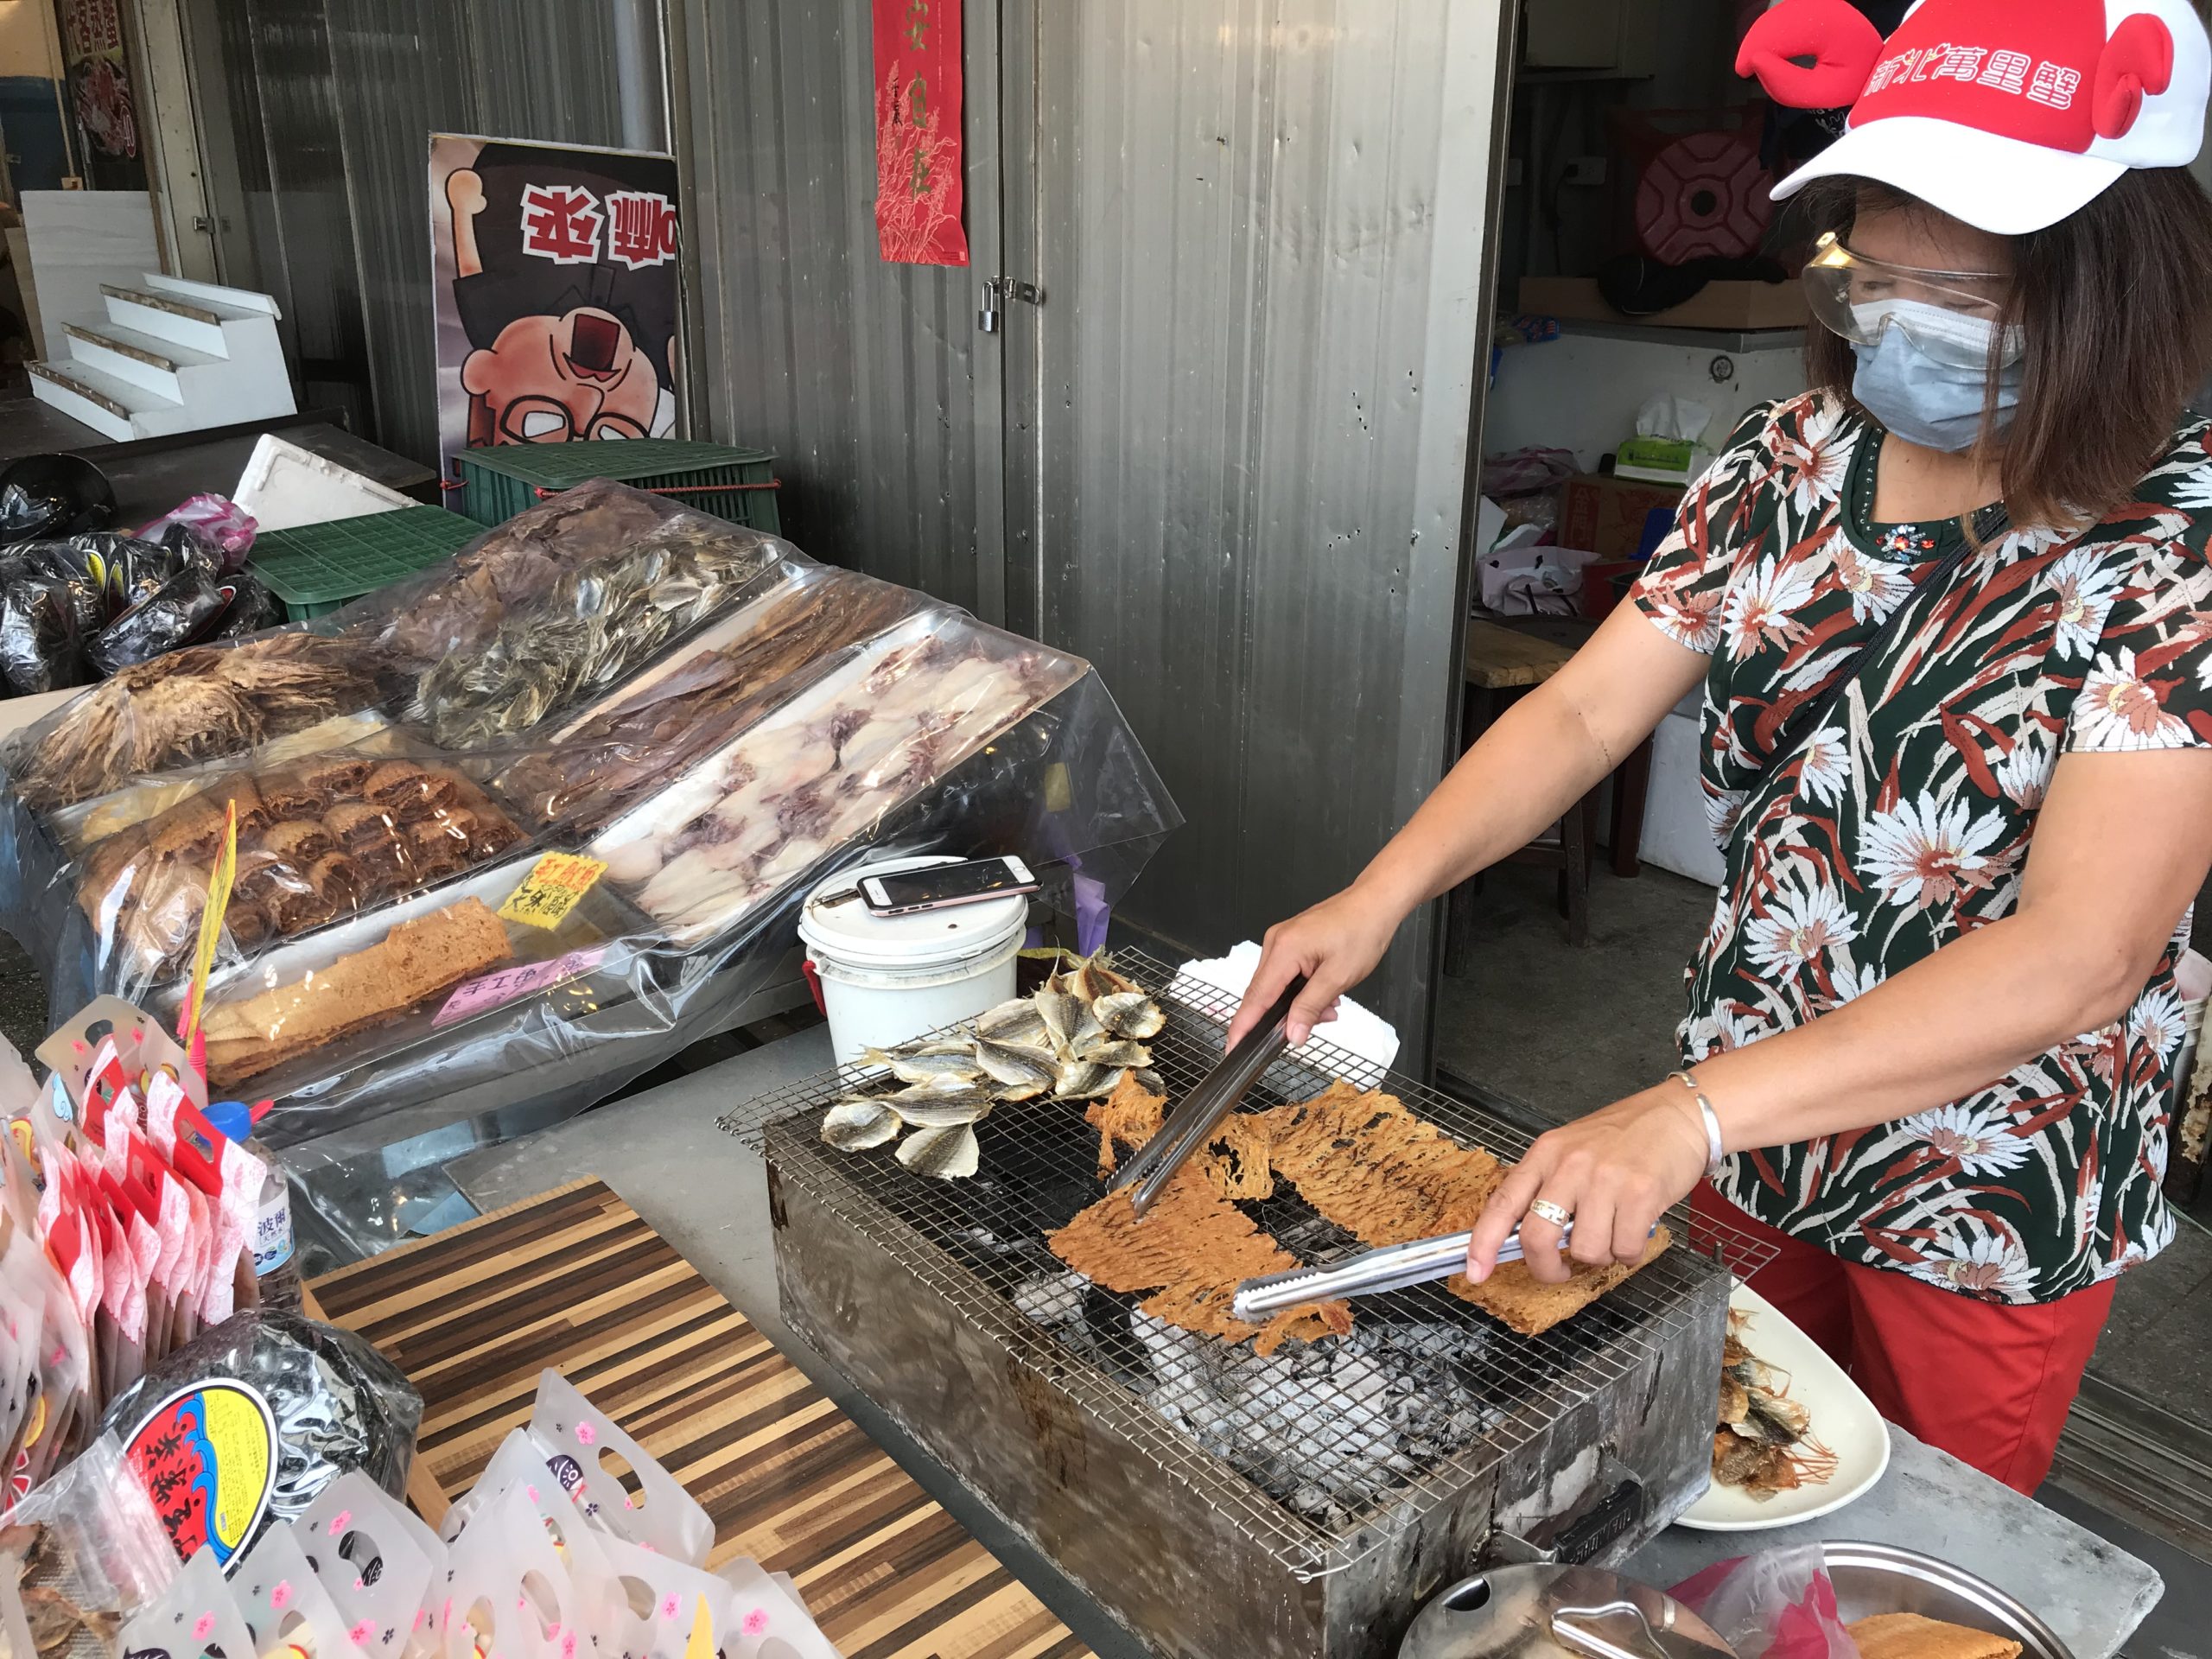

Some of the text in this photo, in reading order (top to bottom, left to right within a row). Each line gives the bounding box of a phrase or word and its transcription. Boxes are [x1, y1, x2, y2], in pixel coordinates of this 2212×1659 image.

[1863, 43, 2081, 110] 新北萬里蟹
